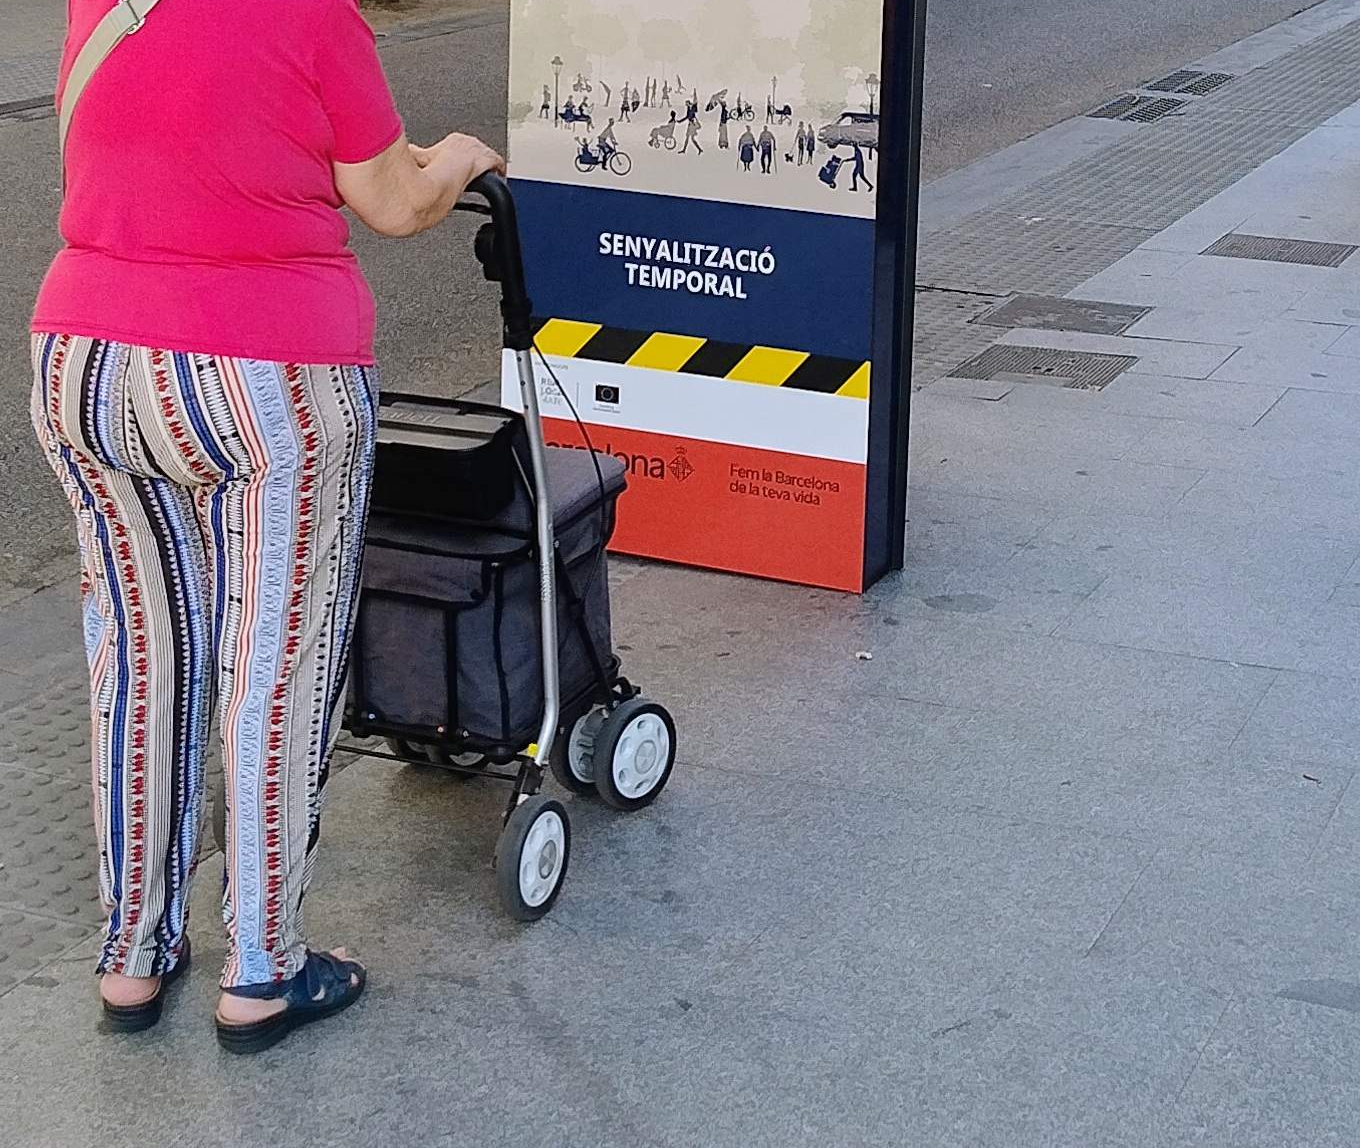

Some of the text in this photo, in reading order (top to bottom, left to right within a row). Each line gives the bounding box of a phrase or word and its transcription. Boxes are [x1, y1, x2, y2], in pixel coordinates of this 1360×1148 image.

[599, 232, 776, 275] SENYALITZACIÓ
[625, 263, 747, 299] TEMPORAL
[729, 480, 820, 505] de la teva vida
[730, 463, 840, 492] Fem la Barcelona
